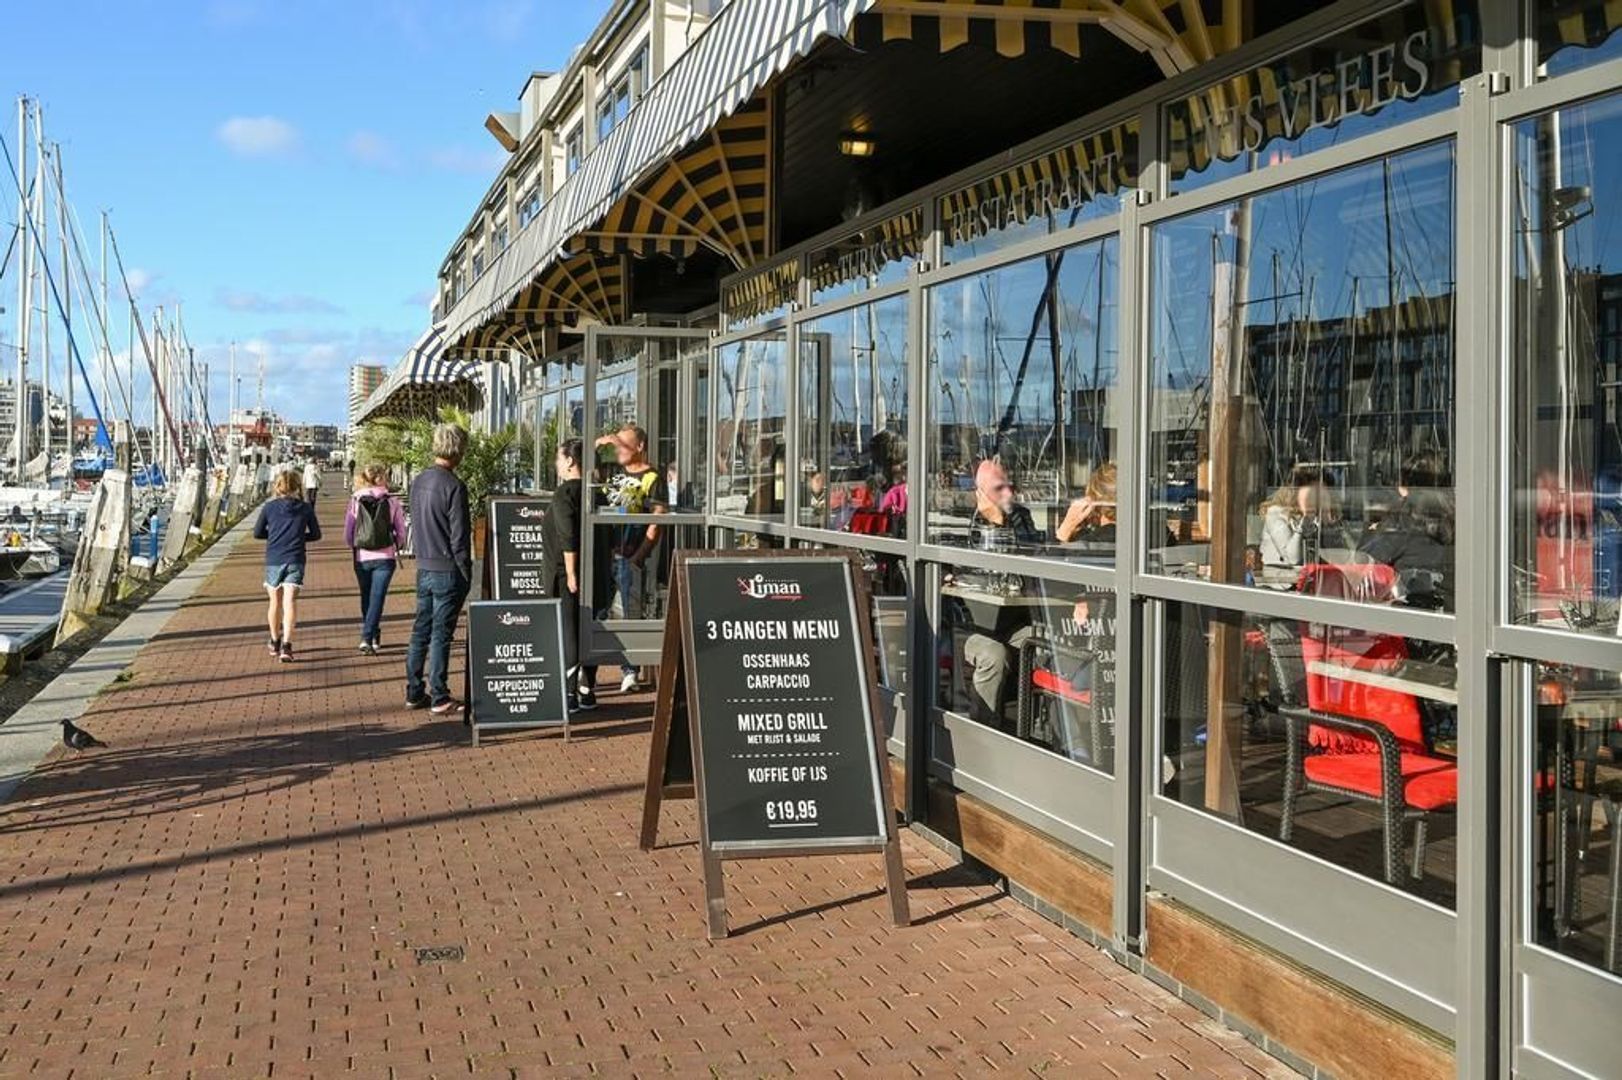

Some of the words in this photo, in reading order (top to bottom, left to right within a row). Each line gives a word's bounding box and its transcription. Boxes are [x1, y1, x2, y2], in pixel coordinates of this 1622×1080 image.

[1202, 95, 1264, 161] VIS
[1277, 30, 1429, 139] VLEES
[952, 151, 1121, 244] RESTAURANT
[749, 573, 801, 599] Liman
[707, 620, 717, 640] 3
[722, 620, 788, 640] GANGEN
[792, 619, 840, 639] MENU
[495, 643, 533, 658] KOFFIE
[743, 653, 811, 669] OSSENHAAS
[487, 679, 545, 692] CAPPUCCINO
[747, 674, 810, 689] CARPACCIO
[737, 713, 784, 732] MIXED
[788, 712, 828, 730] GRILL
[747, 734, 763, 744] MET
[764, 734, 784, 744] RIJST
[785, 733, 792, 744] &
[793, 733, 821, 743] SALADE
[748, 767, 789, 783] KOFFIE
[792, 766, 807, 782] OF
[809, 765, 828, 781] IJS
[767, 800, 818, 821] €19,95
